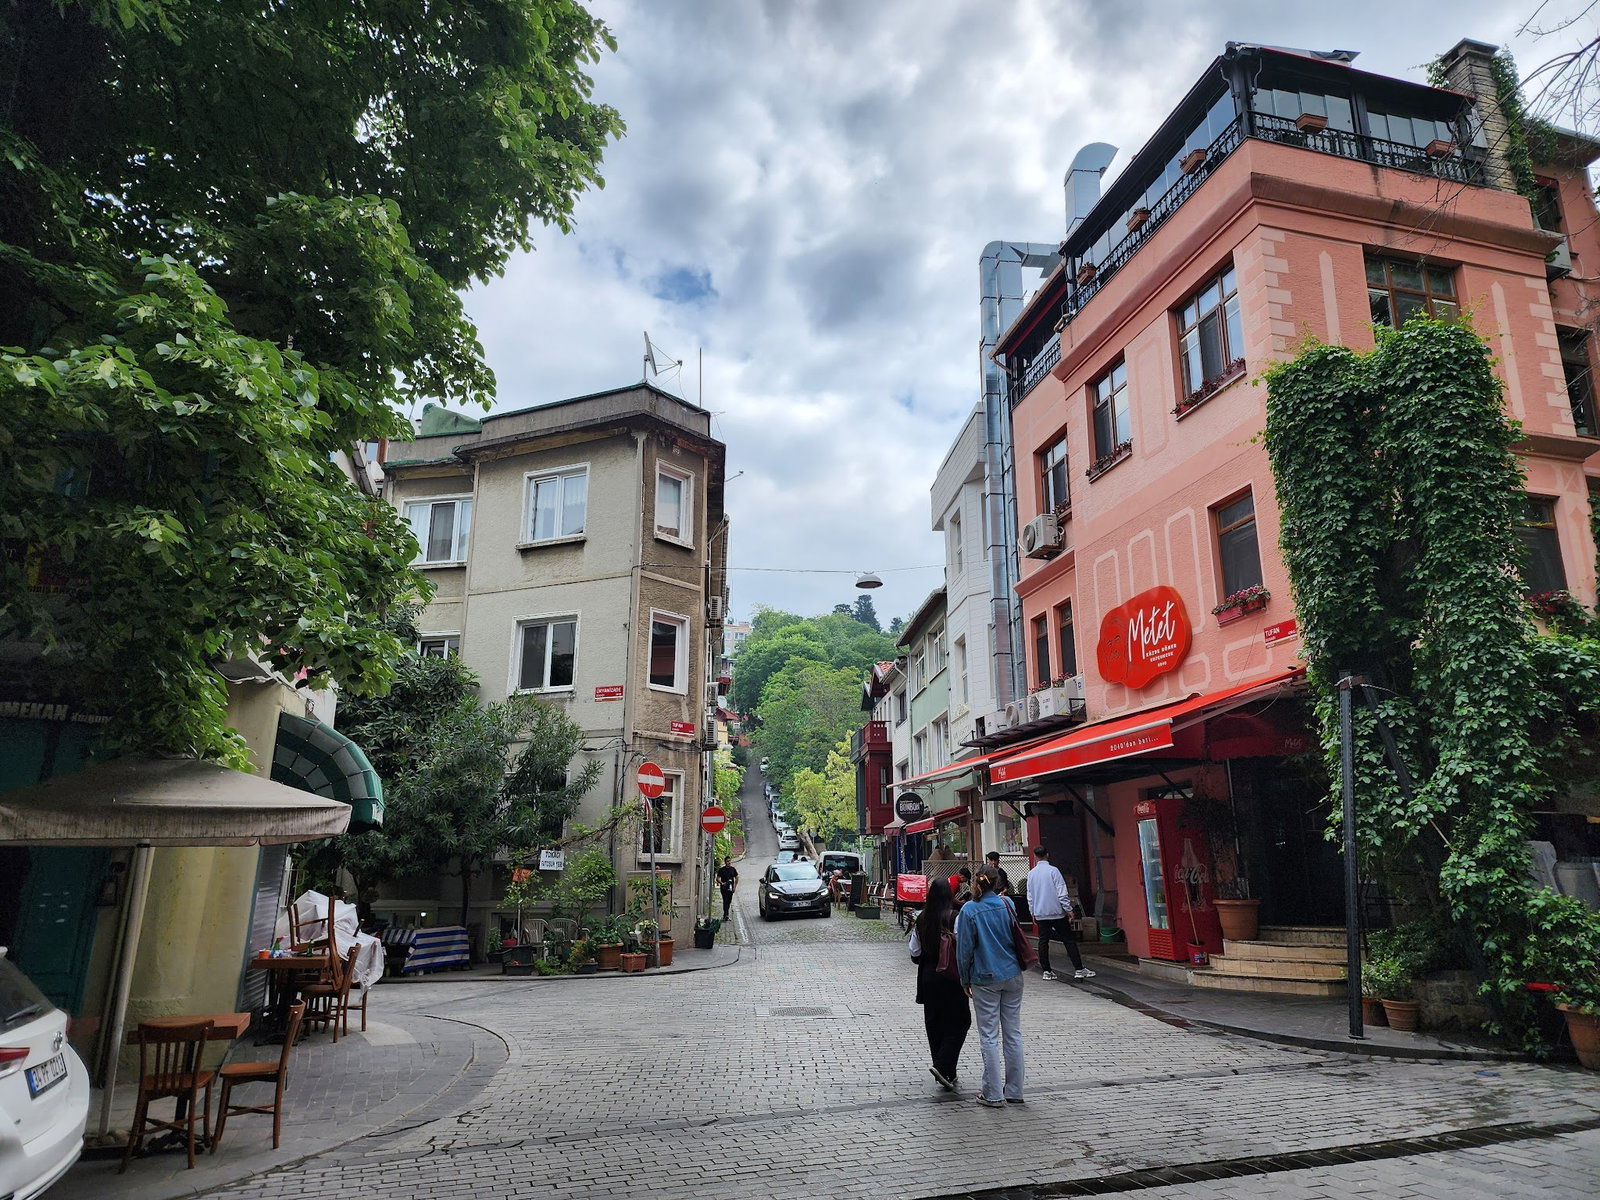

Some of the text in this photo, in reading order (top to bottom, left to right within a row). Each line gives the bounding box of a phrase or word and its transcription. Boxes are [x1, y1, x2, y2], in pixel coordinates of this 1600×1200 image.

[1128, 600, 1175, 662] Metet
[1265, 627, 1280, 636] TUFAN
[33, 1067, 43, 1088] 34
